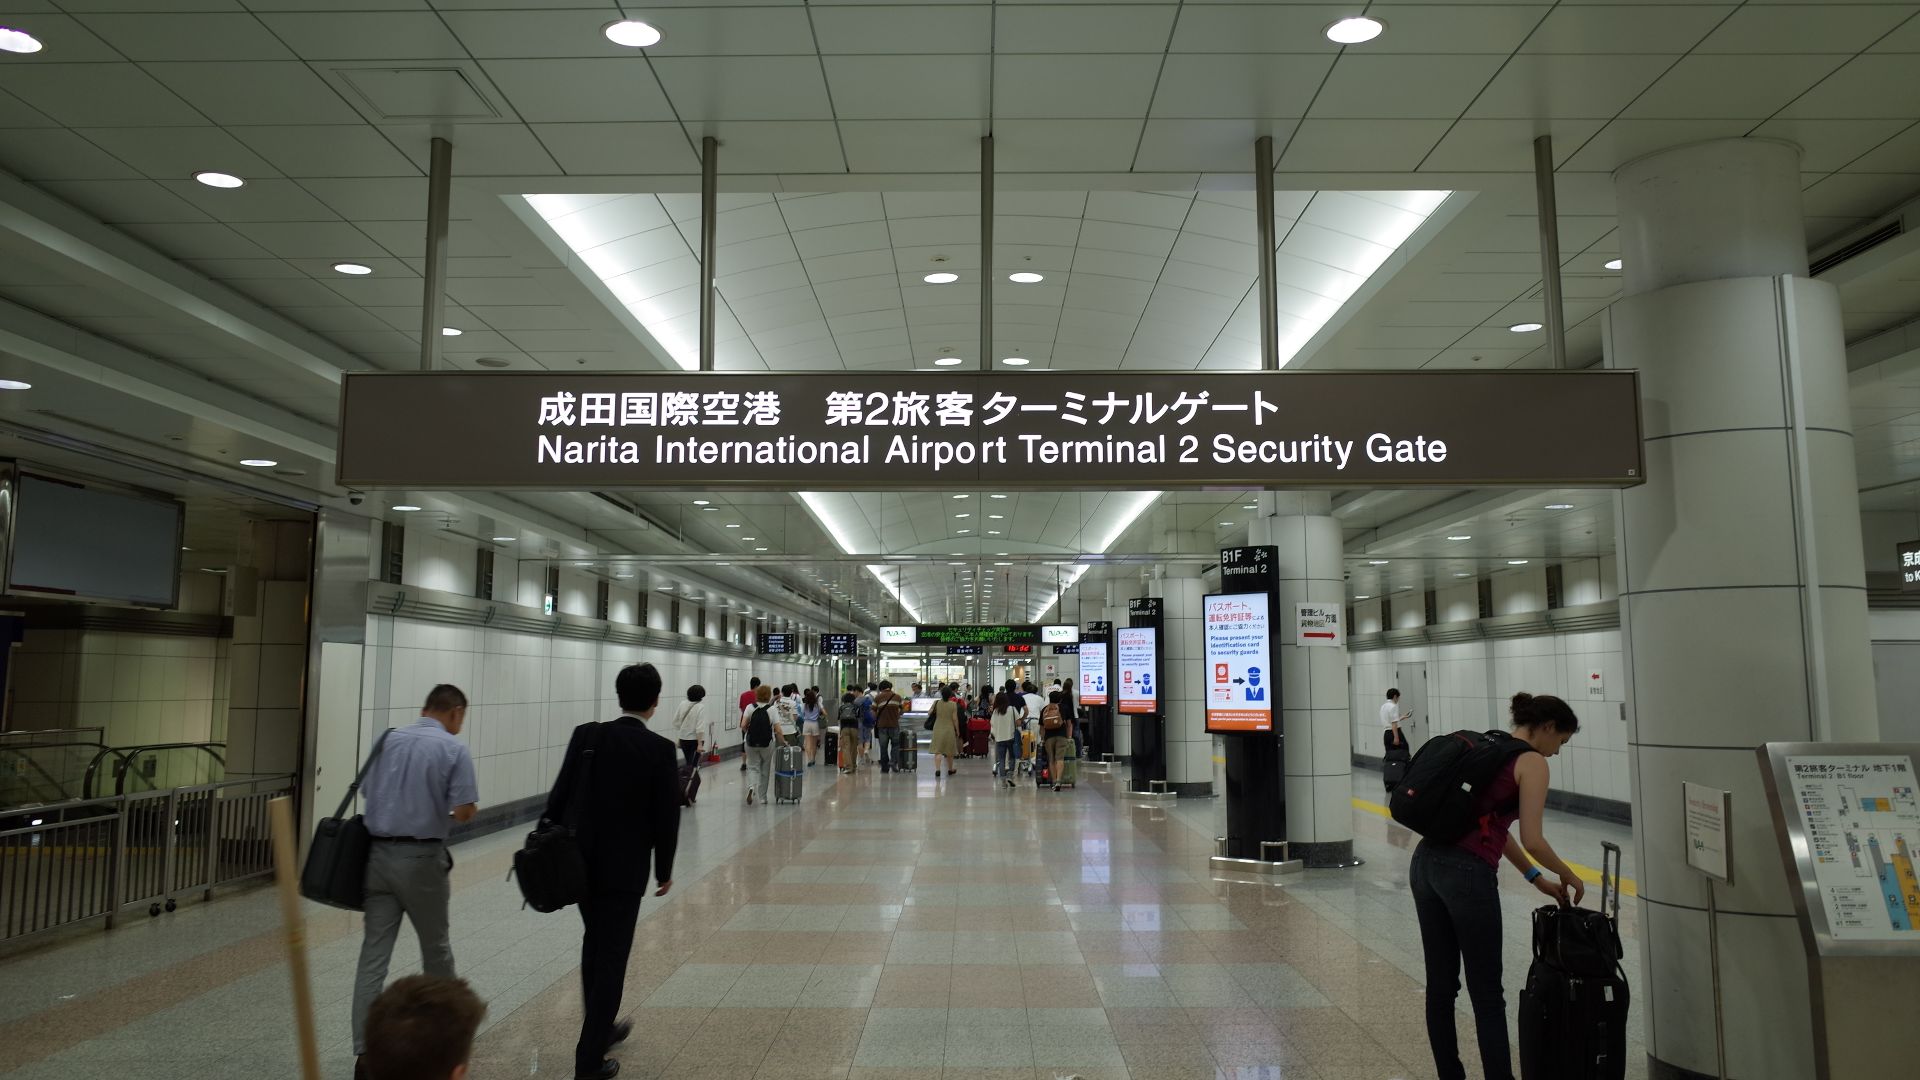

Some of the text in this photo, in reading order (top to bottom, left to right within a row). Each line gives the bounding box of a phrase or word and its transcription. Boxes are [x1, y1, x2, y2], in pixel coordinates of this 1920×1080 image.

[537, 391, 1279, 427] 成田国際空港 第2旅客ターミナルゲート
[537, 433, 1447, 471] Narita International Airport Terminal 2 Security Gate
[1222, 549, 1242, 563] B1F
[1222, 564, 1267, 575] Terminal 2
[1904, 572, 1914, 582] to
[1129, 599, 1141, 609] B1F
